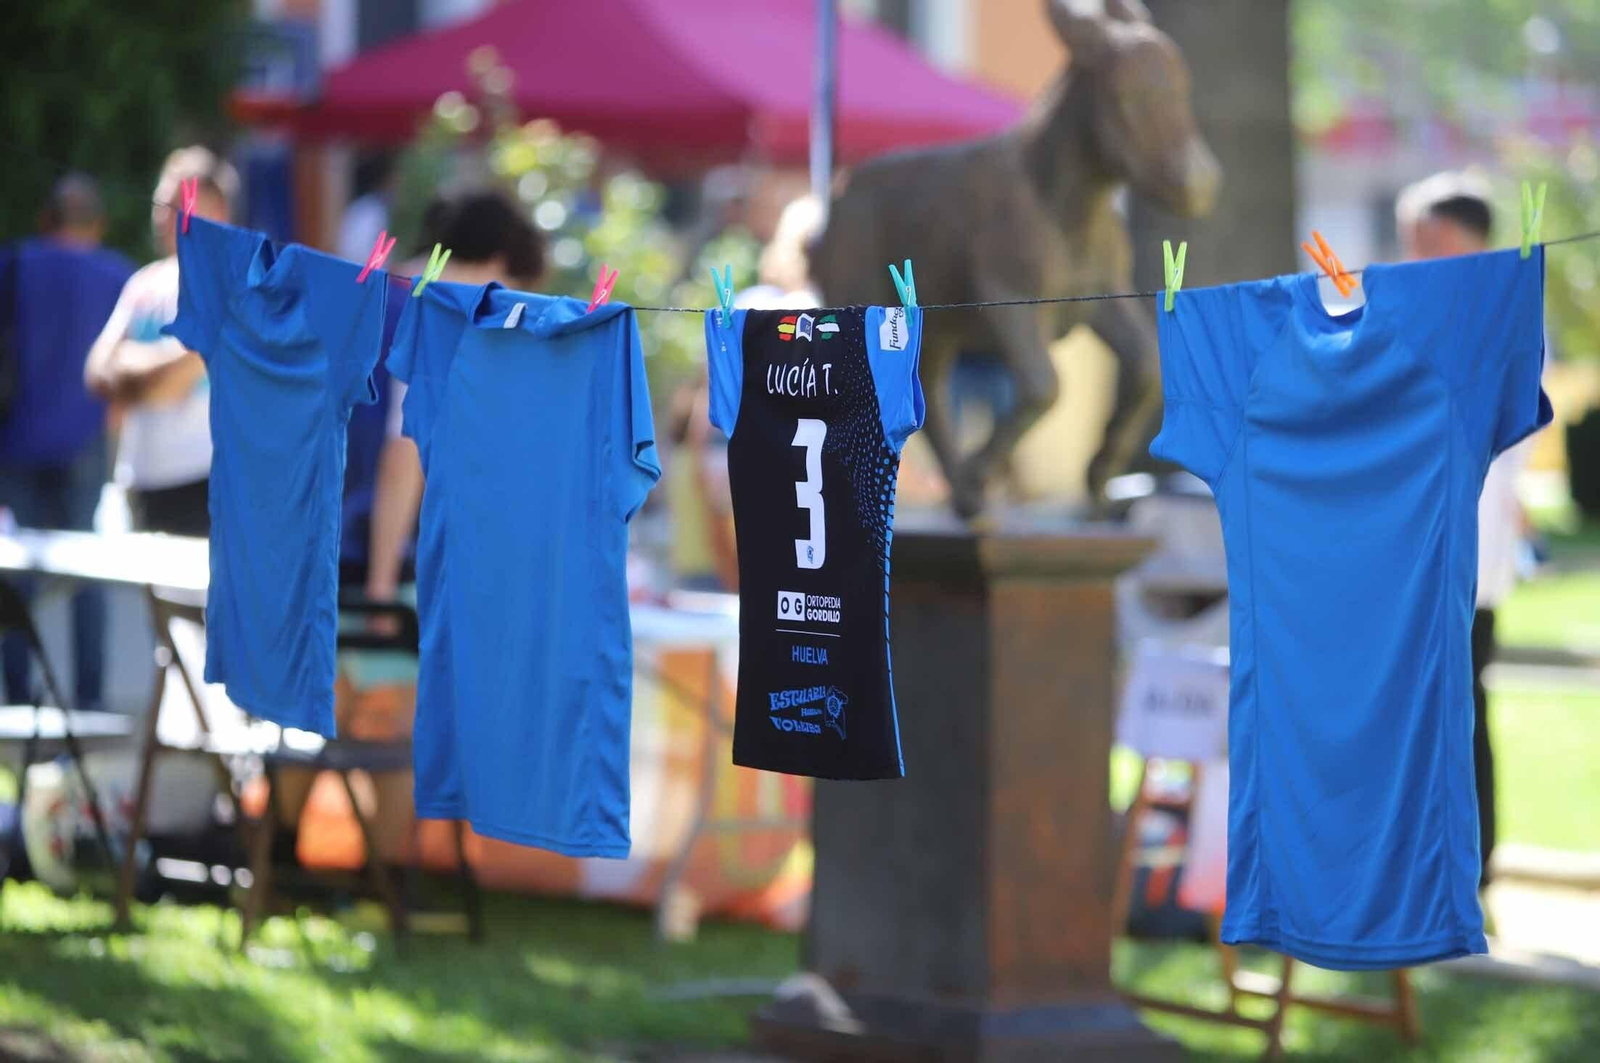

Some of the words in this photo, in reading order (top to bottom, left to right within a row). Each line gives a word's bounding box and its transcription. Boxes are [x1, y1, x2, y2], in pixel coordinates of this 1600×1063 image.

[766, 358, 817, 398] LUCÍA
[822, 363, 839, 396] T.
[791, 418, 828, 570] 3
[806, 594, 841, 609] ORTOPEDIA
[806, 608, 841, 623] GORDILLO
[791, 645, 829, 666] HUELVA
